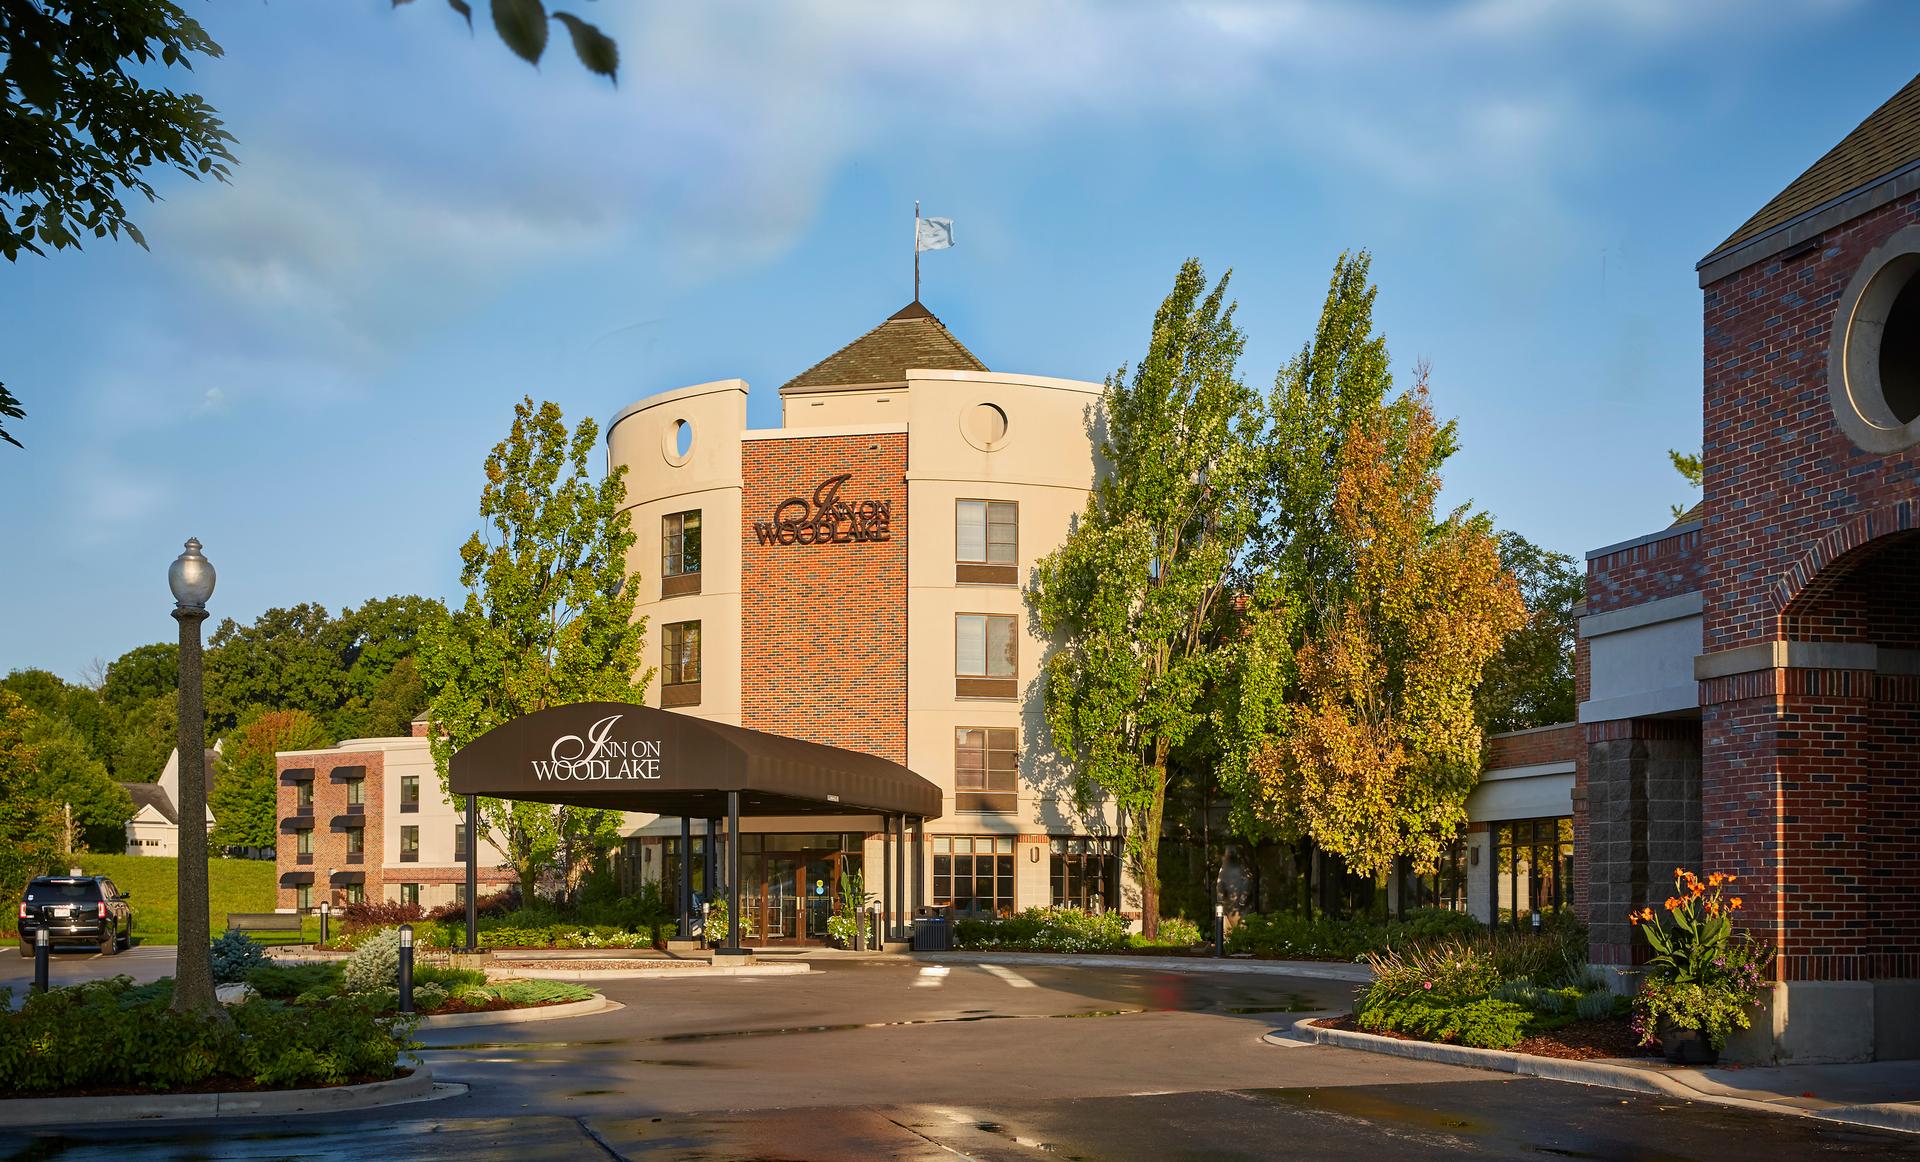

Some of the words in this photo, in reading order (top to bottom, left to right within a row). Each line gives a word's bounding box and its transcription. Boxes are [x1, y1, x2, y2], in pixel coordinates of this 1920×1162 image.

[859, 500, 892, 522] ON
[753, 518, 891, 546] WOODLAKE
[551, 714, 628, 768] INN
[631, 740, 662, 758] ON
[531, 759, 661, 781] WOODLAKE
